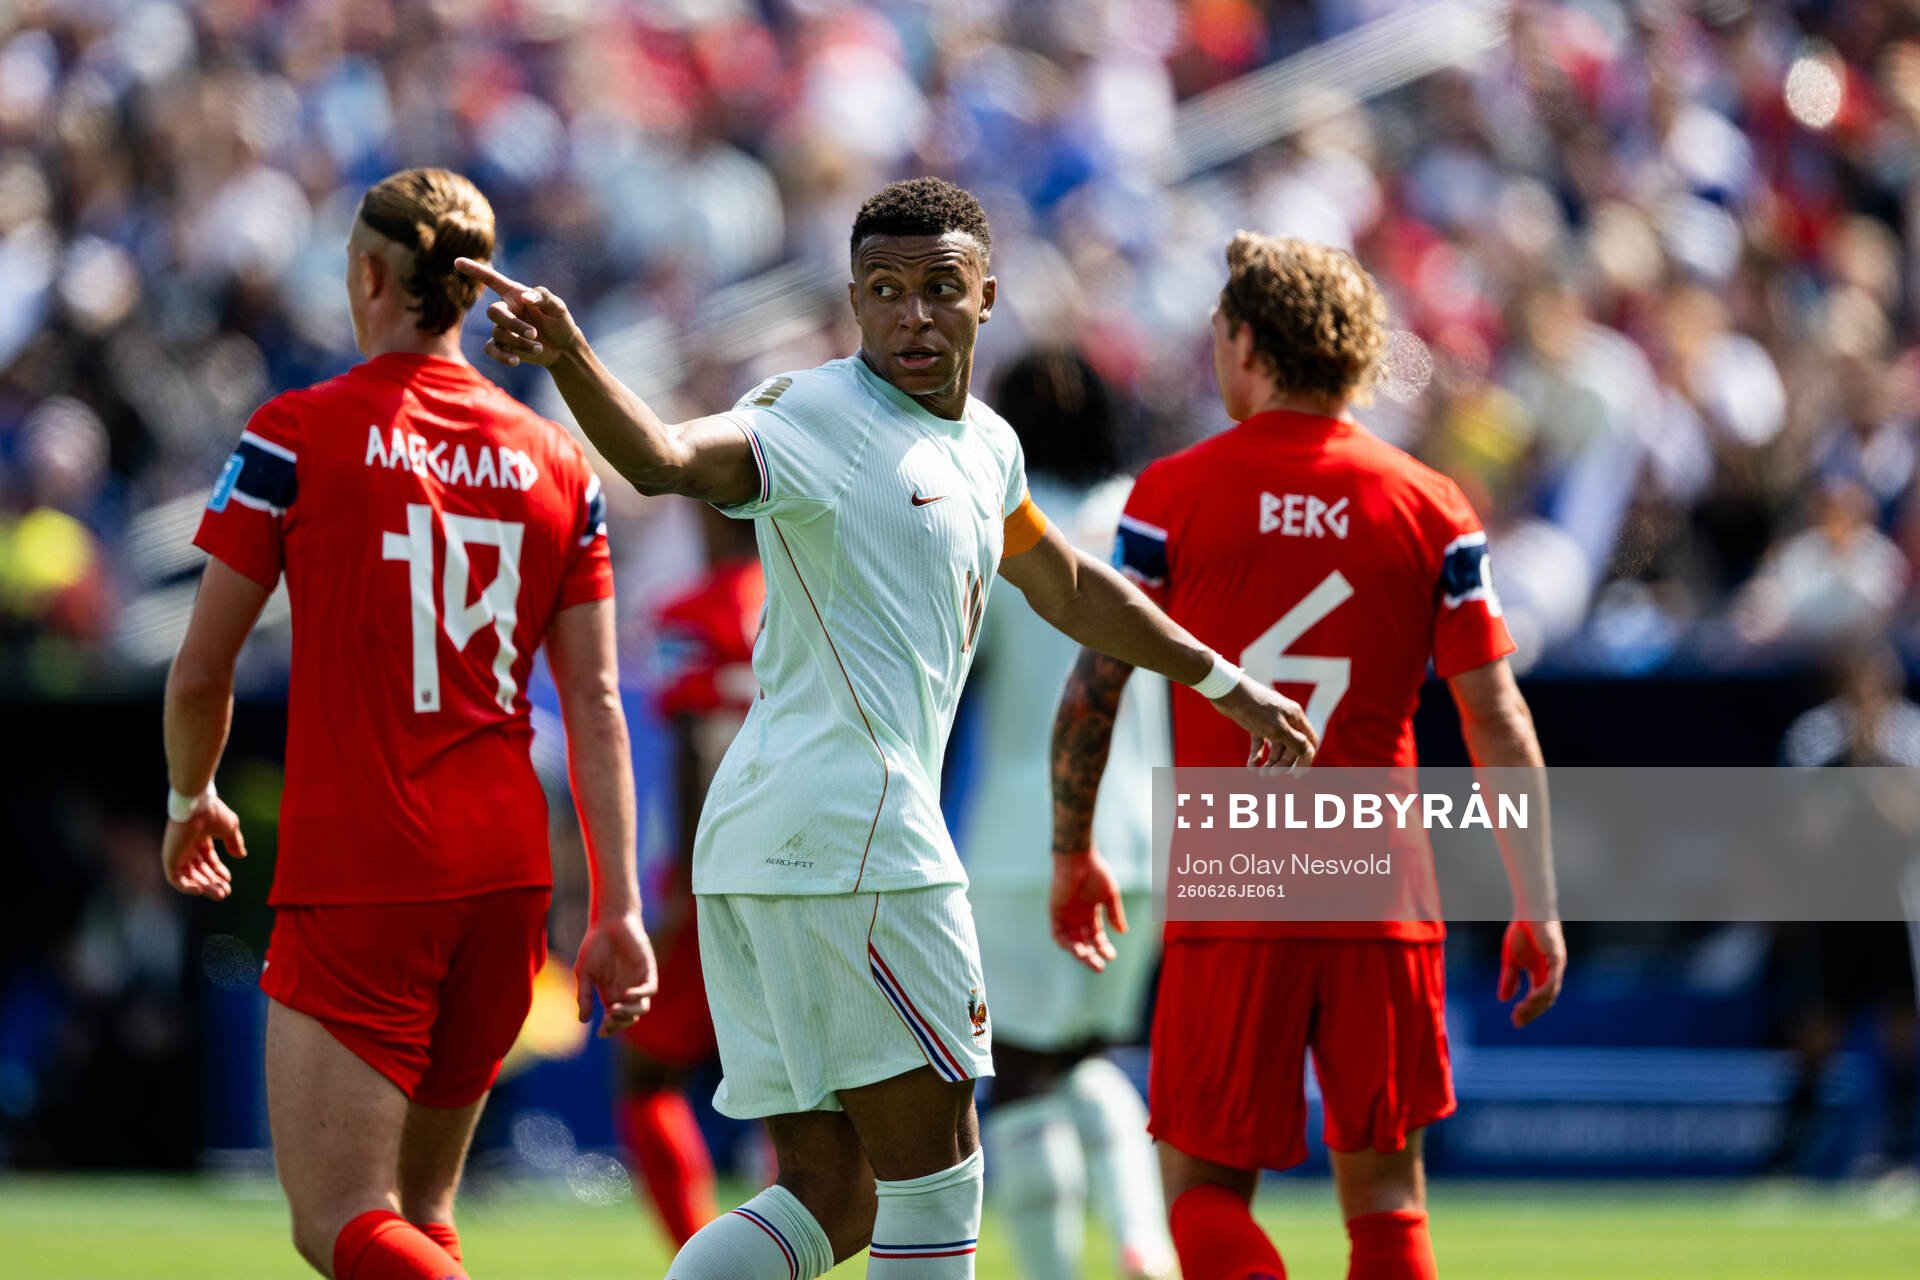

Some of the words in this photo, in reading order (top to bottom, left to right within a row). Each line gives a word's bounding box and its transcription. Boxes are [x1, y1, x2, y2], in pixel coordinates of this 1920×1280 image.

[365, 425, 539, 492] AAGGAARD
[1260, 491, 1349, 539] BERG
[382, 503, 525, 715] 19
[1240, 569, 1355, 745] 6
